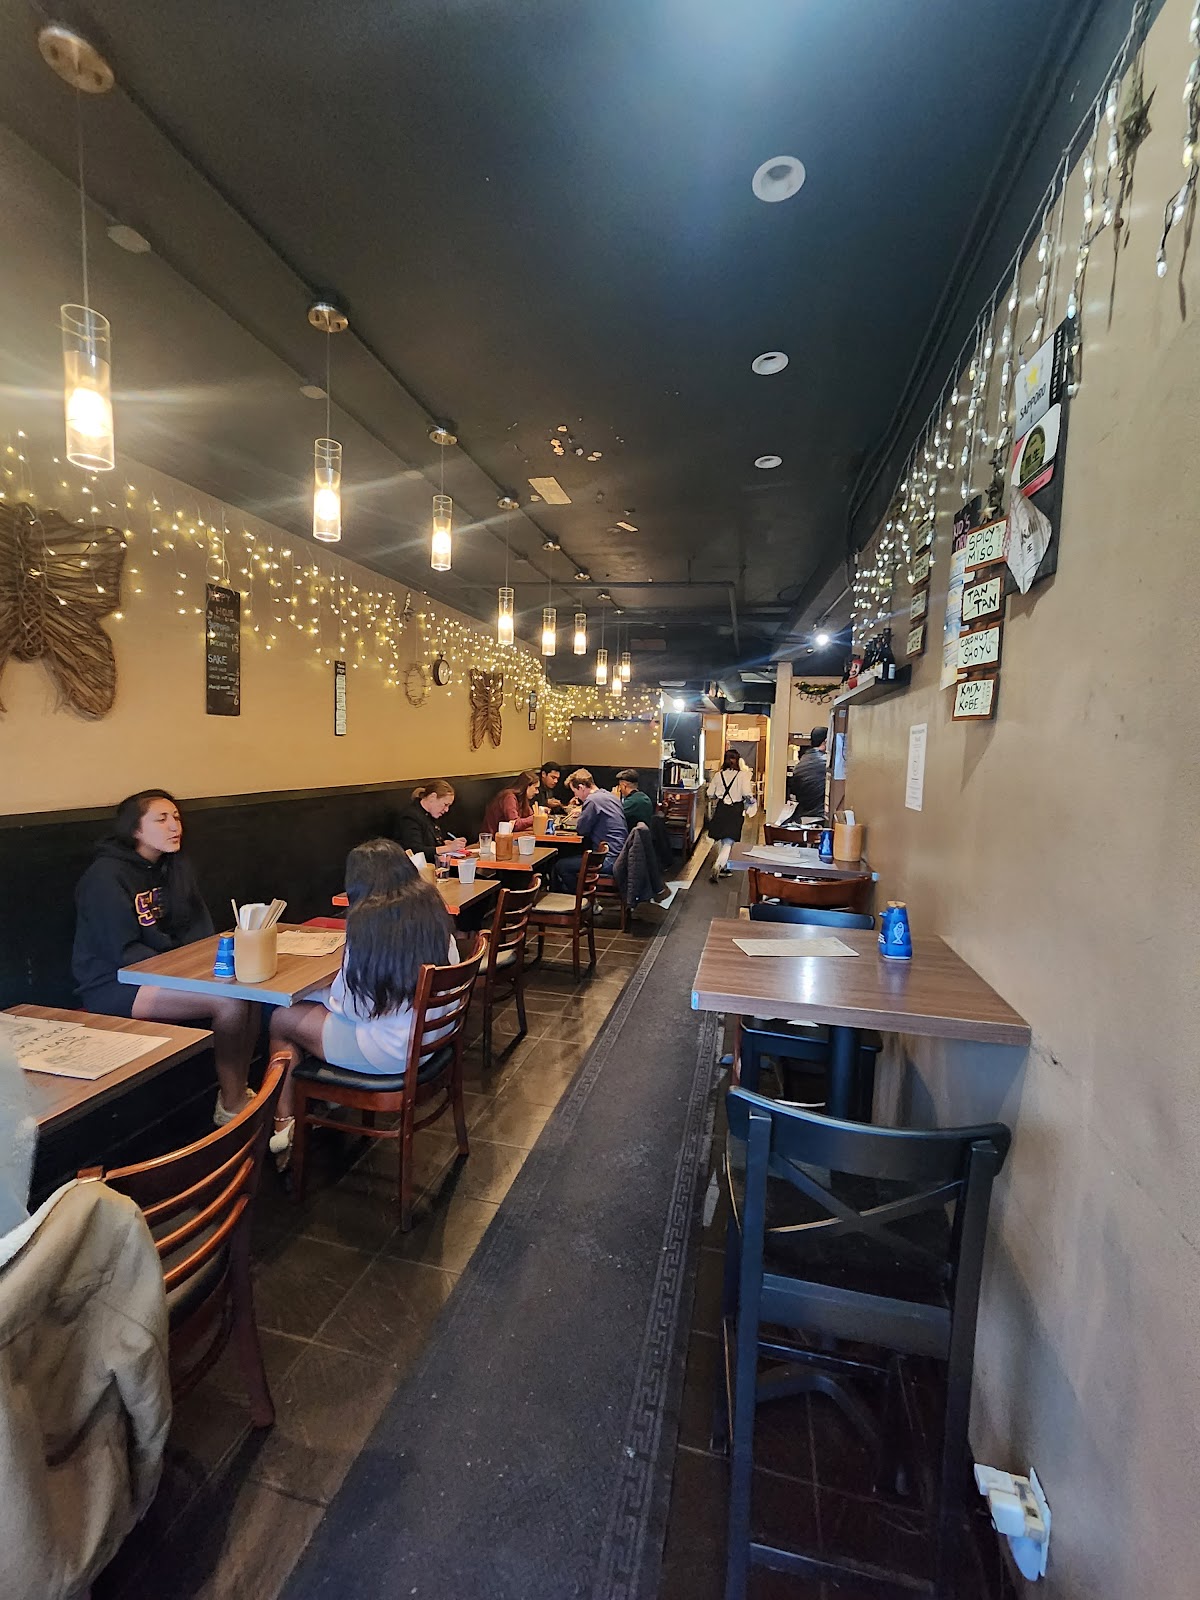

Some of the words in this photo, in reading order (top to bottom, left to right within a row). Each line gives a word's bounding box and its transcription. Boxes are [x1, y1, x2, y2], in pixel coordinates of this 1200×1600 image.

[1019, 382, 1047, 421] SAPPORO
[968, 527, 995, 551] SPICY
[967, 545, 994, 564] MISO
[967, 584, 988, 603] TAN
[974, 593, 997, 614] TAN
[960, 631, 990, 648] COCONUT
[207, 653, 228, 666] SAKE
[962, 642, 992, 664] SHOYU
[958, 698, 979, 711] KOBE
